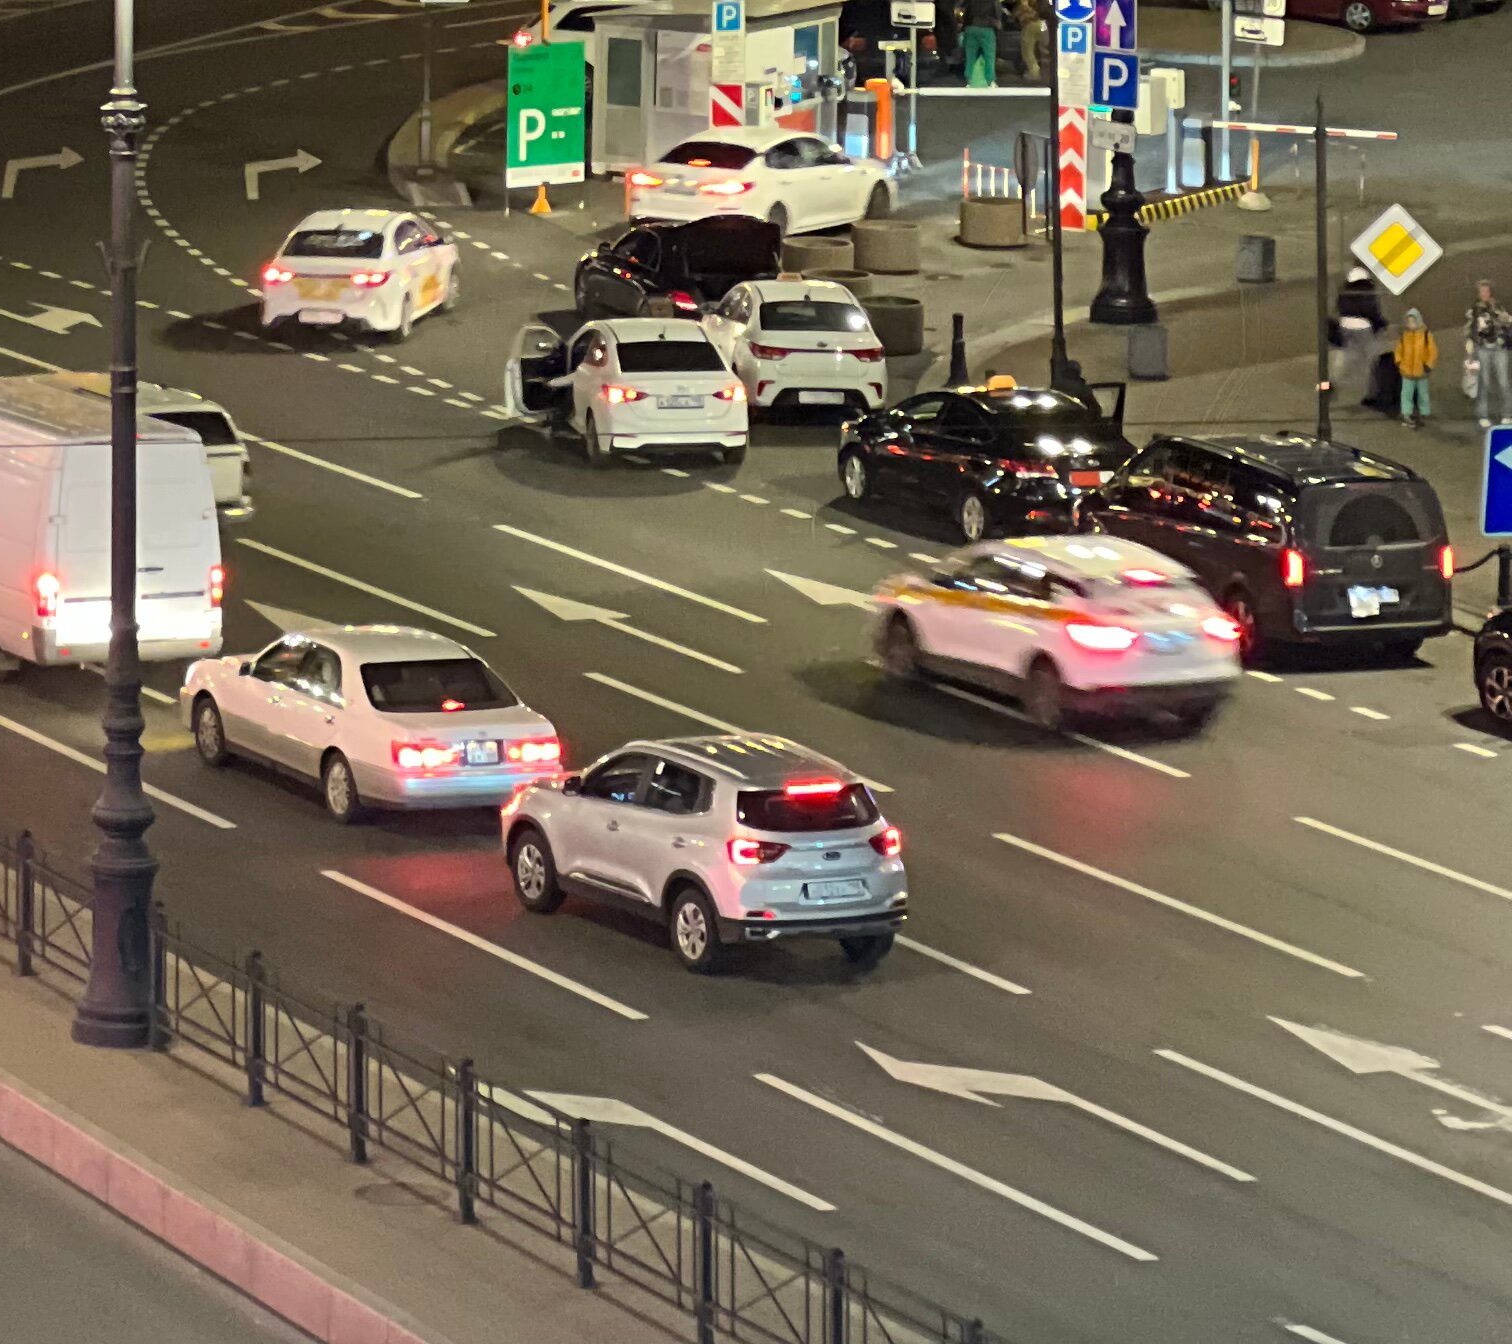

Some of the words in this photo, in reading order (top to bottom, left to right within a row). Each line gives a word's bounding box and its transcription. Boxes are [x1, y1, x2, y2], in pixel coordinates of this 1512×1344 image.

[721, 5, 737, 29] P
[1067, 27, 1083, 49] P
[1102, 57, 1129, 101] P
[519, 107, 546, 162] P
